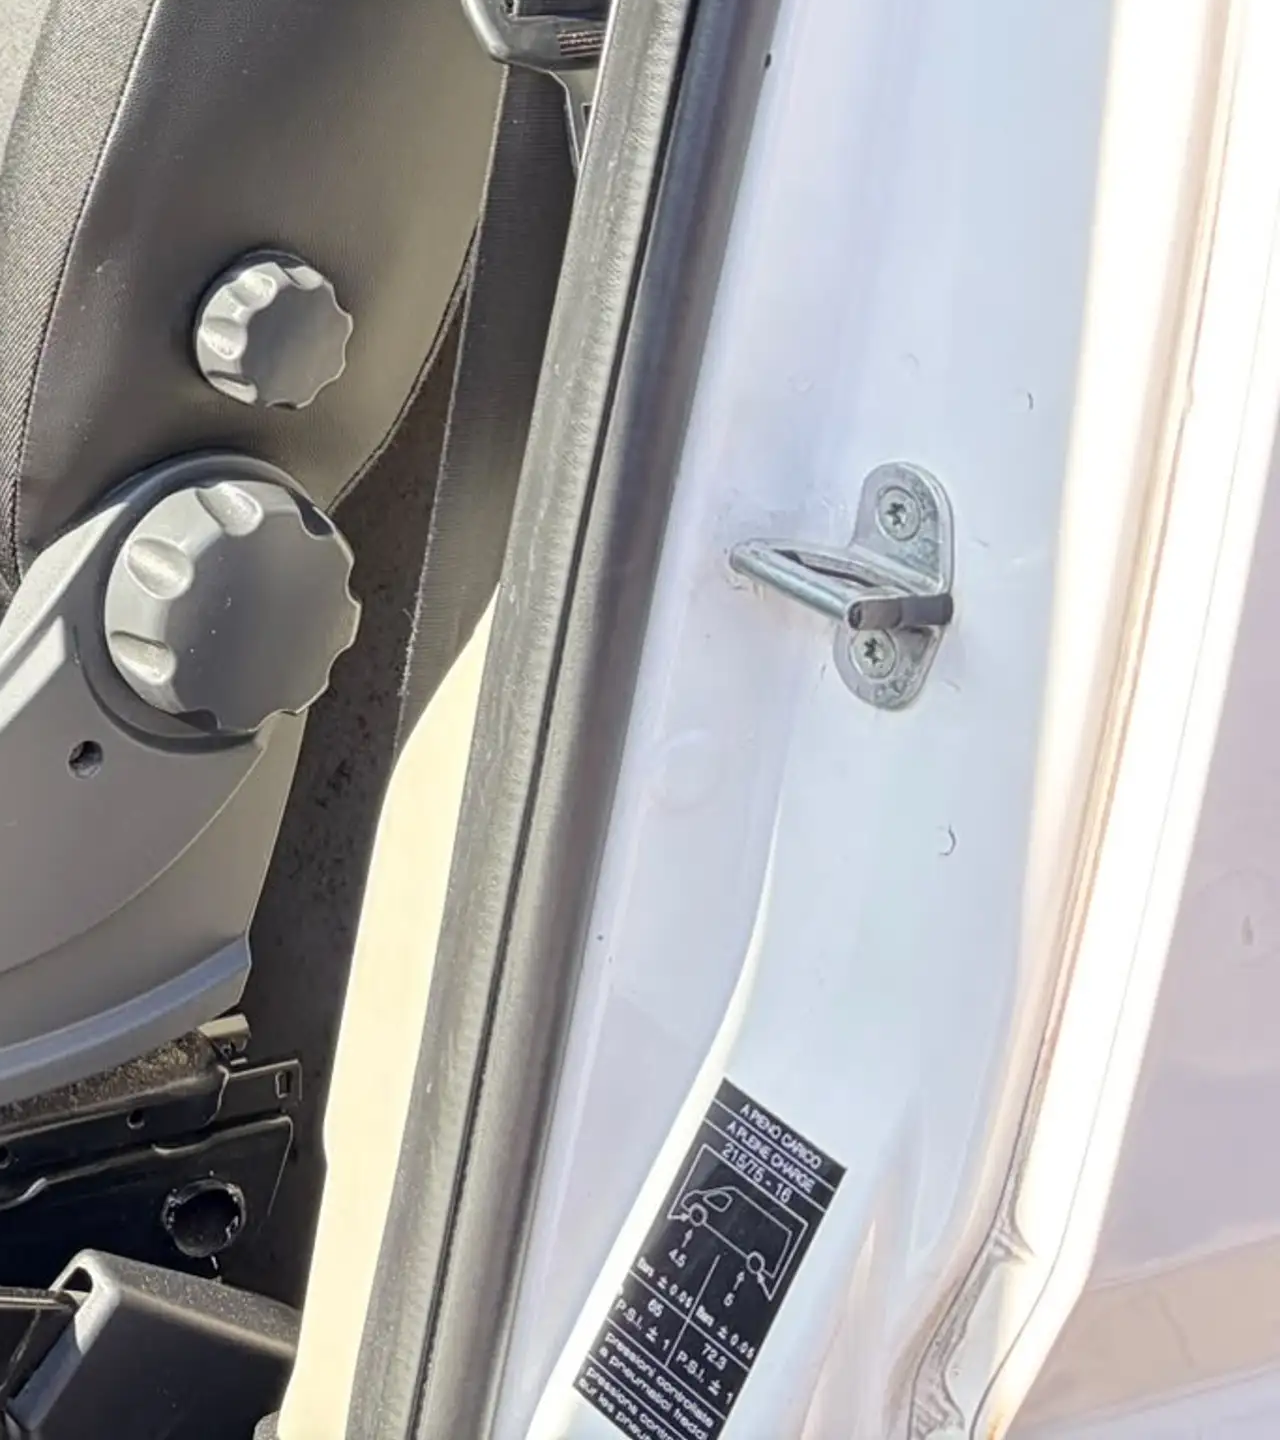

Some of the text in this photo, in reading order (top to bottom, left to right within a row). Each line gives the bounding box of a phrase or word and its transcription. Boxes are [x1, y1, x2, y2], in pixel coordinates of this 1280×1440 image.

[720, 1142, 765, 1183] 215/75
[584, 1364, 638, 1415] pressions
[603, 1330, 713, 1428] pressioni controllate
[608, 1355, 672, 1411] pneumatici
